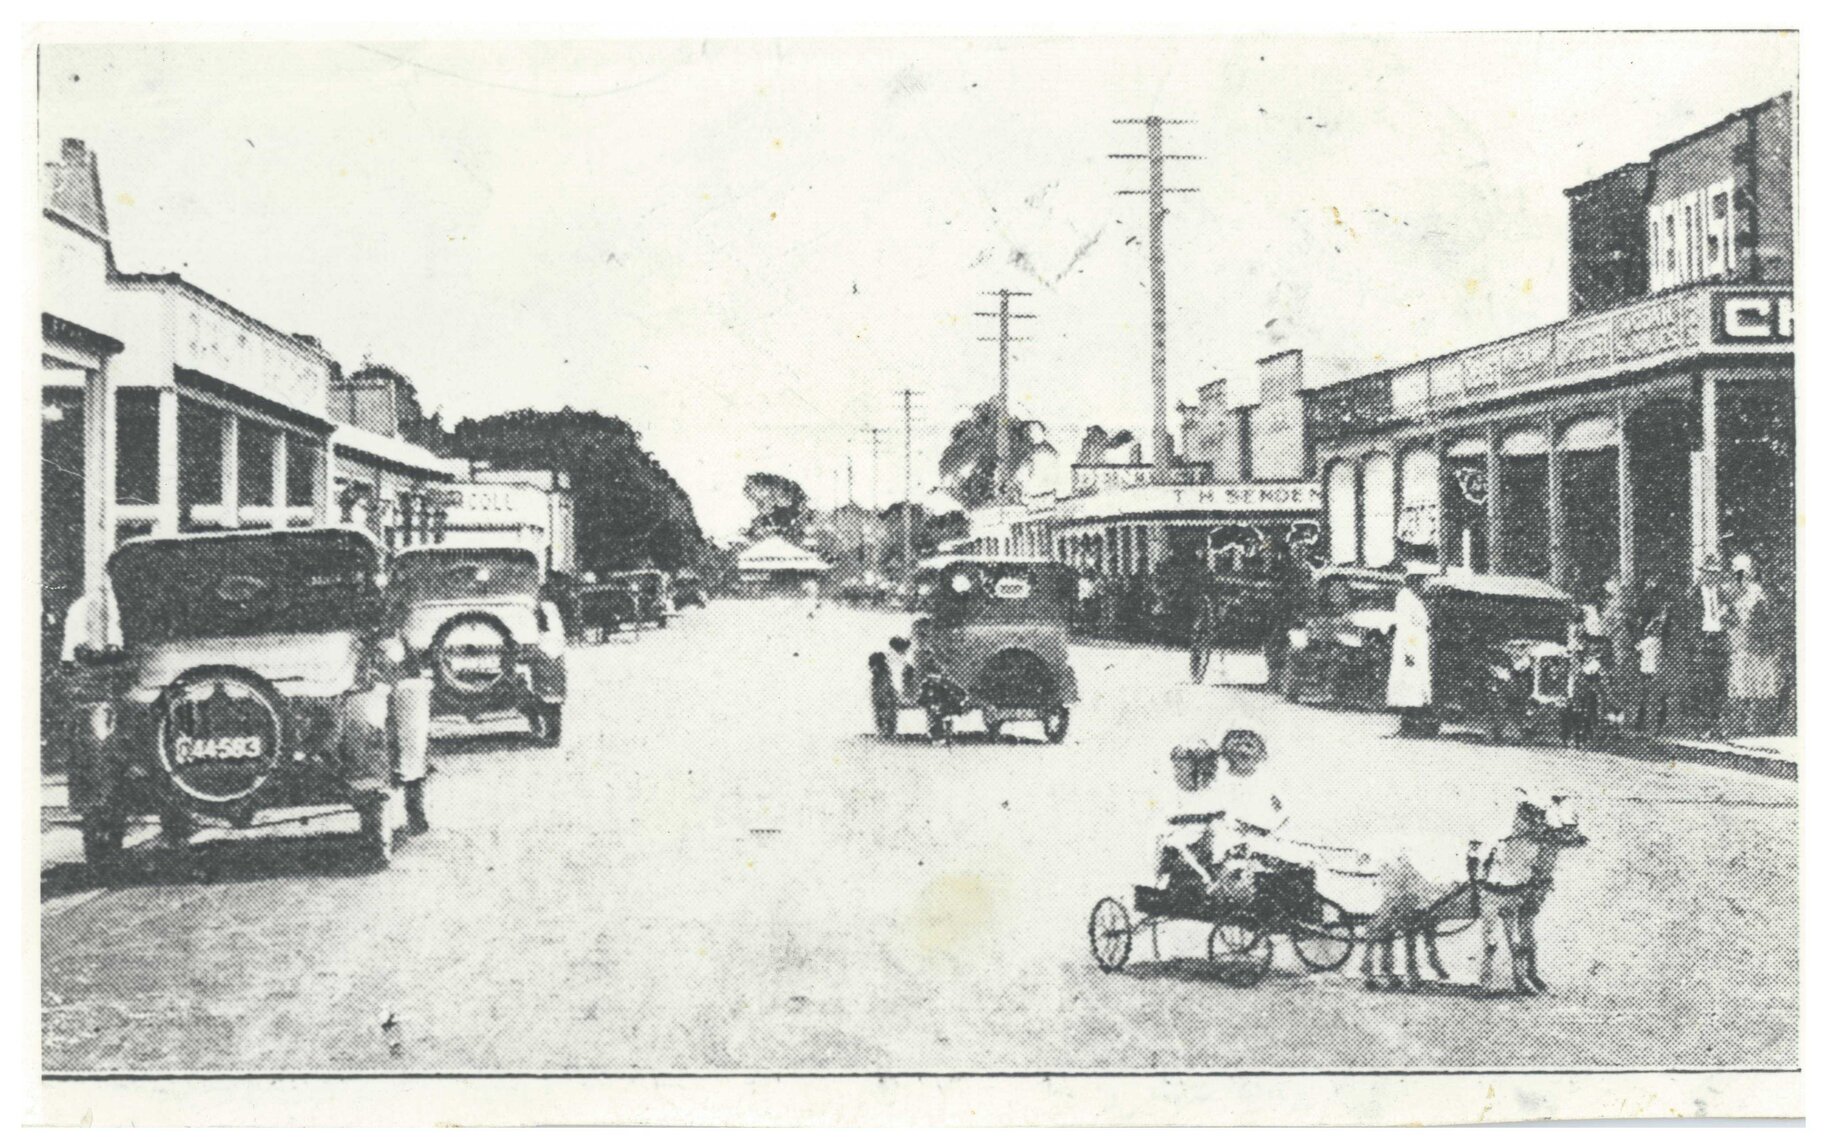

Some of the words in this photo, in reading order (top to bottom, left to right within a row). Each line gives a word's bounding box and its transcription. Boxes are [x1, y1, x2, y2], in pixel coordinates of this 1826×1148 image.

[1075, 468, 1204, 489] DENTST
[1173, 489, 1184, 504] T
[1198, 489, 1214, 504] H
